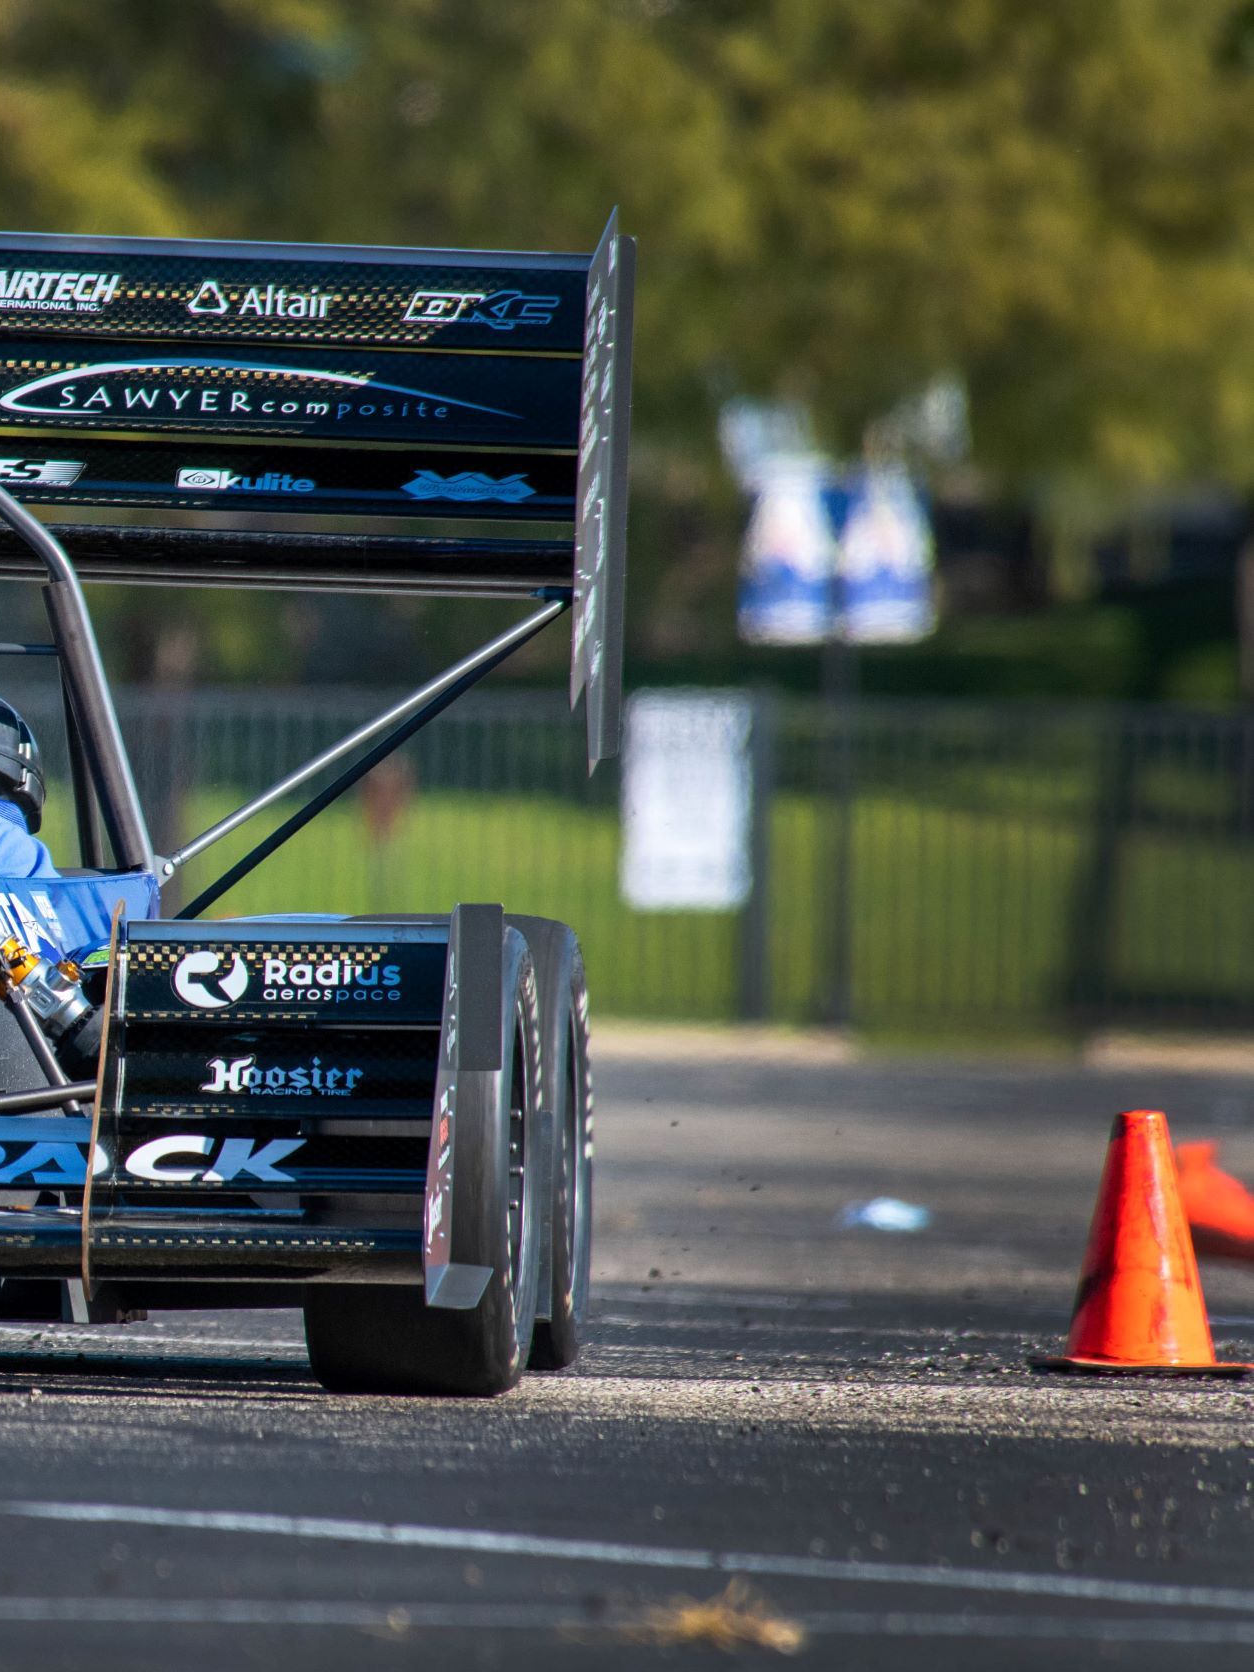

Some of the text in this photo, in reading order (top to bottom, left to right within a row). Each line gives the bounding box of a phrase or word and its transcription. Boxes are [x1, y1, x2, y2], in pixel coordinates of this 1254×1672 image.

[76, 302, 102, 313] INC.
[238, 285, 332, 318] Altair
[59, 385, 252, 413] SAWYER
[219, 470, 315, 492] kulite
[263, 958, 402, 986] Radius
[262, 988, 402, 1004] aerospace
[201, 1055, 364, 1092] Hoosier
[250, 1087, 352, 1097] RACING TIRE
